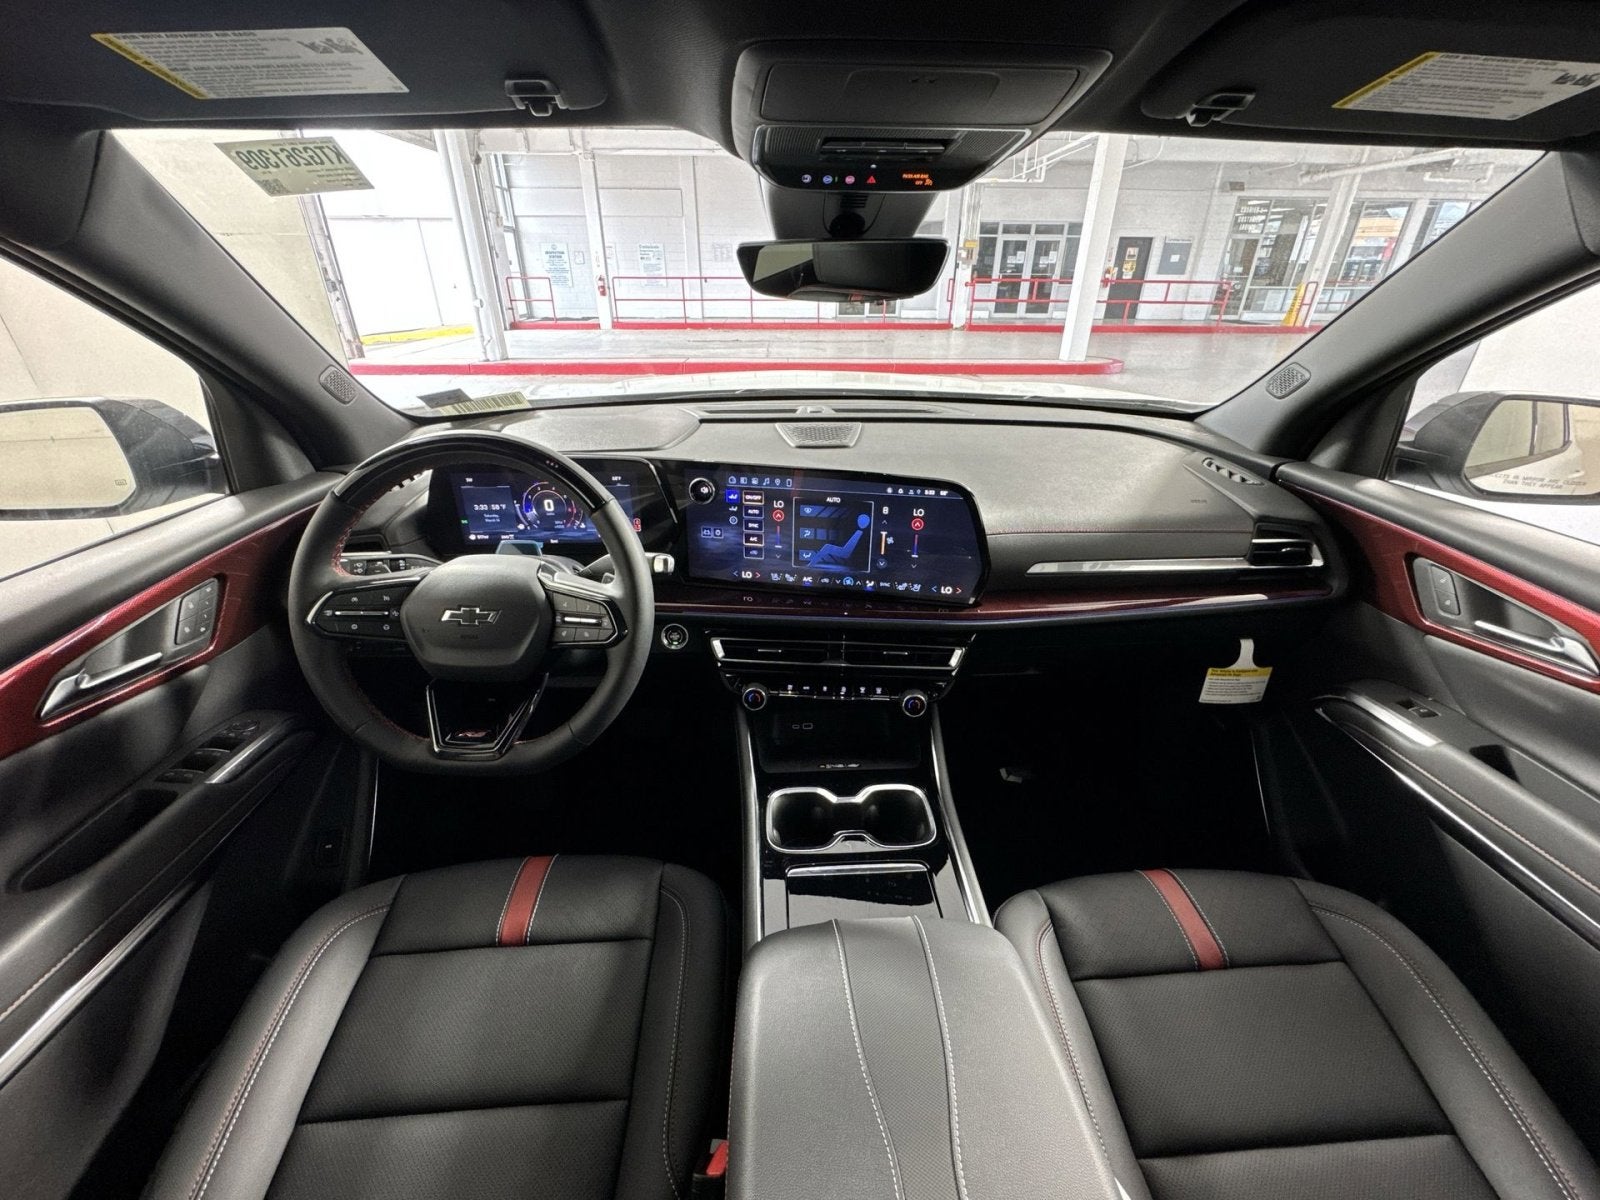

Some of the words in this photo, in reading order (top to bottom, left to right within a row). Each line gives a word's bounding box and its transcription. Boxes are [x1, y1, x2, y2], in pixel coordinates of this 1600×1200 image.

[543, 499, 555, 512] 0
[773, 500, 785, 508] LO
[913, 508, 925, 517] LO
[741, 571, 753, 579] LO
[940, 586, 953, 595] LO
